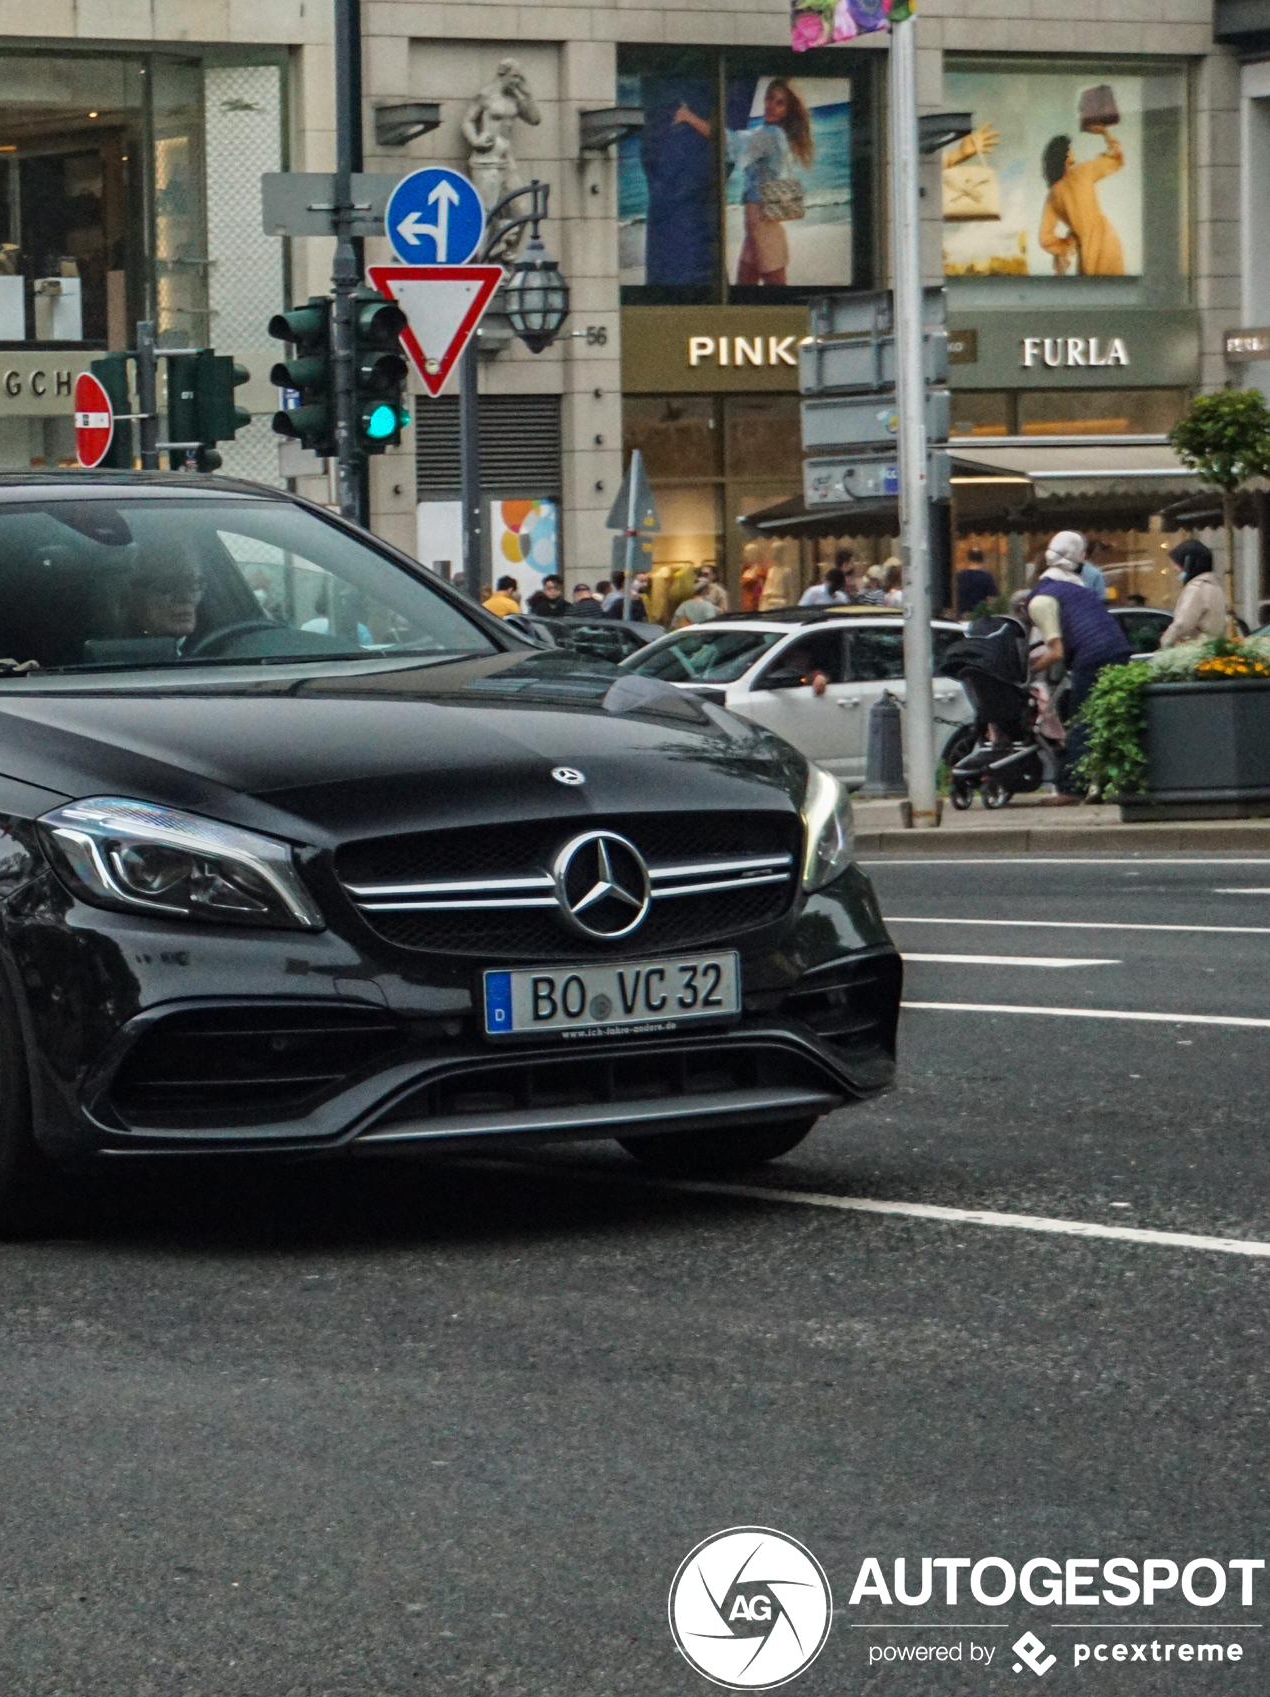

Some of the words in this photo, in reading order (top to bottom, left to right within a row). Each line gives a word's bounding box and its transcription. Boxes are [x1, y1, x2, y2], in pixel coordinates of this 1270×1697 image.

[587, 326, 607, 346] 56
[688, 335, 822, 366] PINK
[1023, 337, 1130, 367] FURLA
[495, 1009, 505, 1022] D
[532, 975, 586, 1021] BO
[617, 966, 667, 1013] VC
[677, 962, 724, 1010] 32
